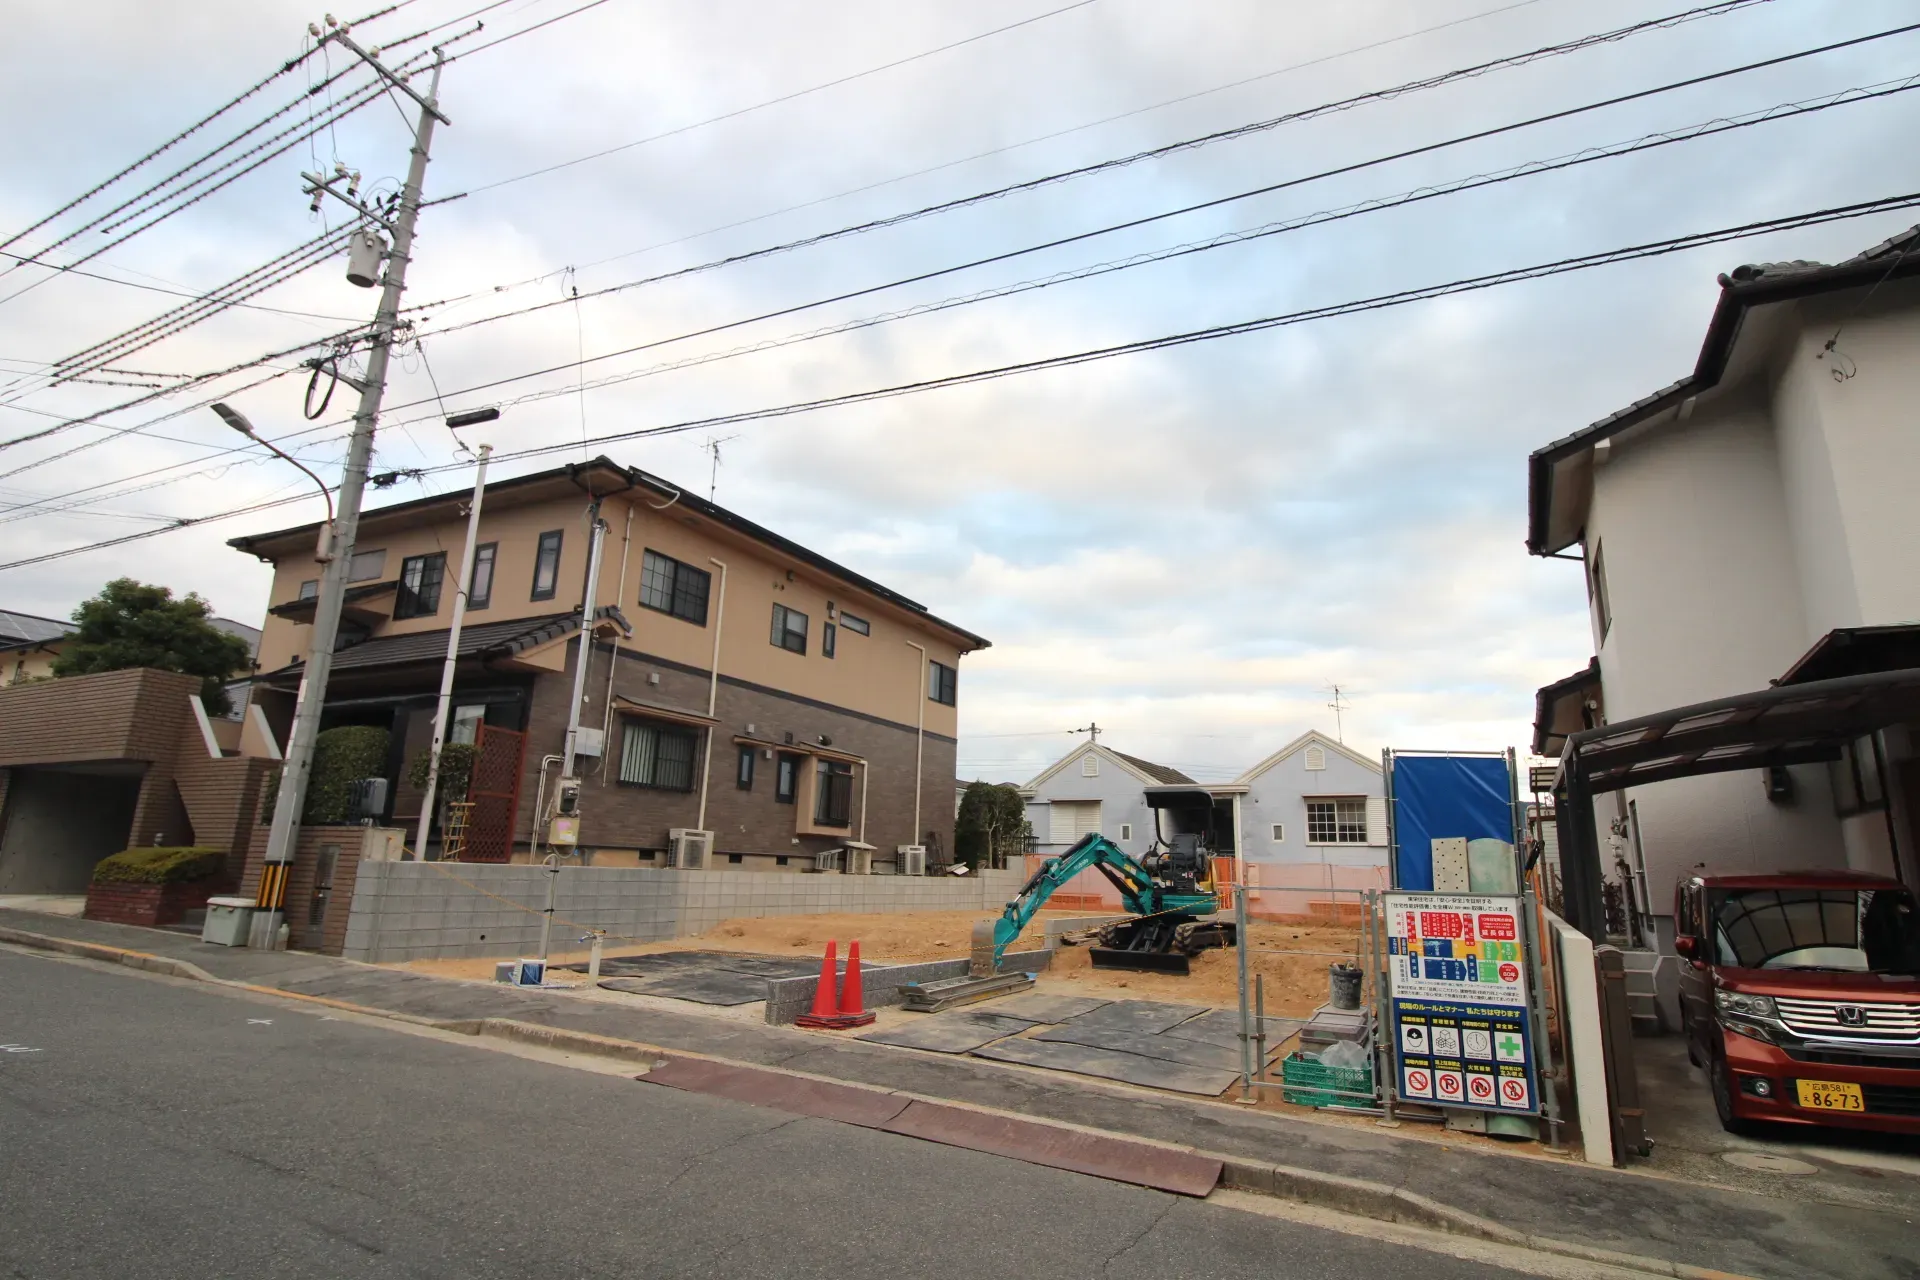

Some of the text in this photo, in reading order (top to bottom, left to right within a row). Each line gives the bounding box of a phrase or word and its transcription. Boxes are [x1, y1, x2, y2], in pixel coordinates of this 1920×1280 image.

[1399, 1002, 1521, 1017] 現場のルールとマナー 私たちは守ります
[1467, 1064, 1491, 1072] 火気厳禁
[1812, 1092, 1860, 1109] 86-73
